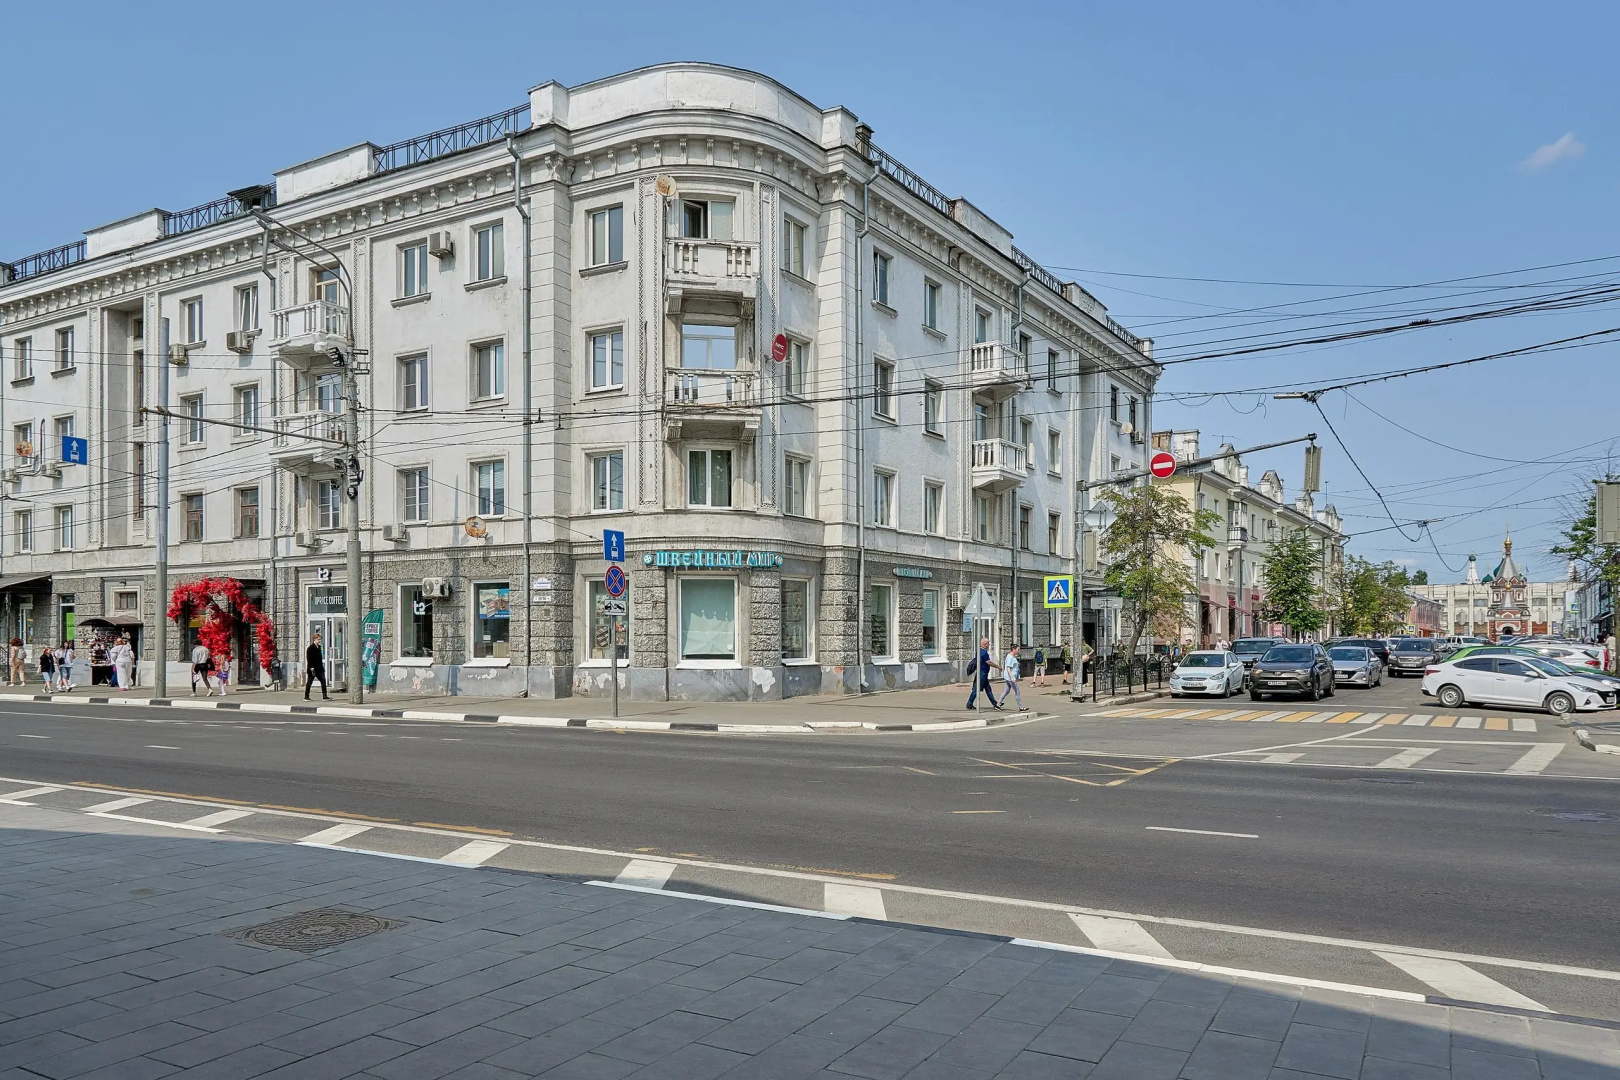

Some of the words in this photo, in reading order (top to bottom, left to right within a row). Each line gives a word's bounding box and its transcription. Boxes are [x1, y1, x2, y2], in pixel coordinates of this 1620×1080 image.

[655, 550, 743, 567] ШВЕЙНЫЙ
[746, 551, 775, 567] МИР
[316, 567, 329, 580] t2
[329, 595, 343, 605] COFFEE
[411, 600, 425, 615] t2
